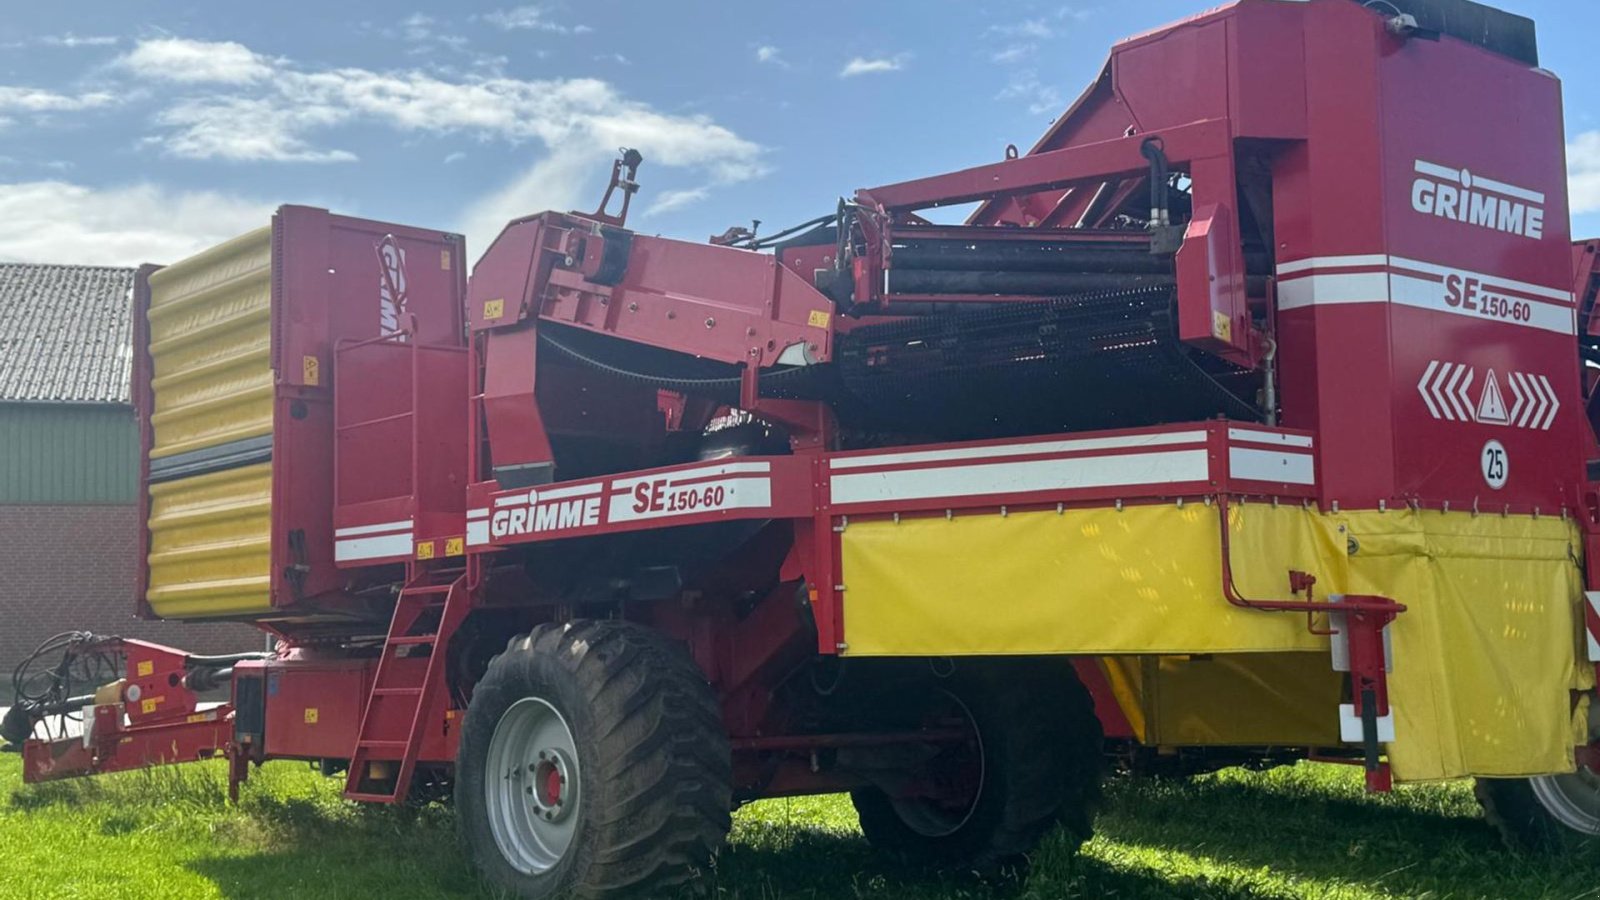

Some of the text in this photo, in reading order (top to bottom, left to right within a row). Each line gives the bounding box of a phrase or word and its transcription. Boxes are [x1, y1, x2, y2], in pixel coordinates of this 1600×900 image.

[1411, 168, 1544, 240] GRIMME
[1444, 274, 1531, 322] SE 150-60
[1486, 448, 1503, 480] 25
[491, 489, 602, 537] GRIMME
[632, 479, 724, 513] SE 150-60
